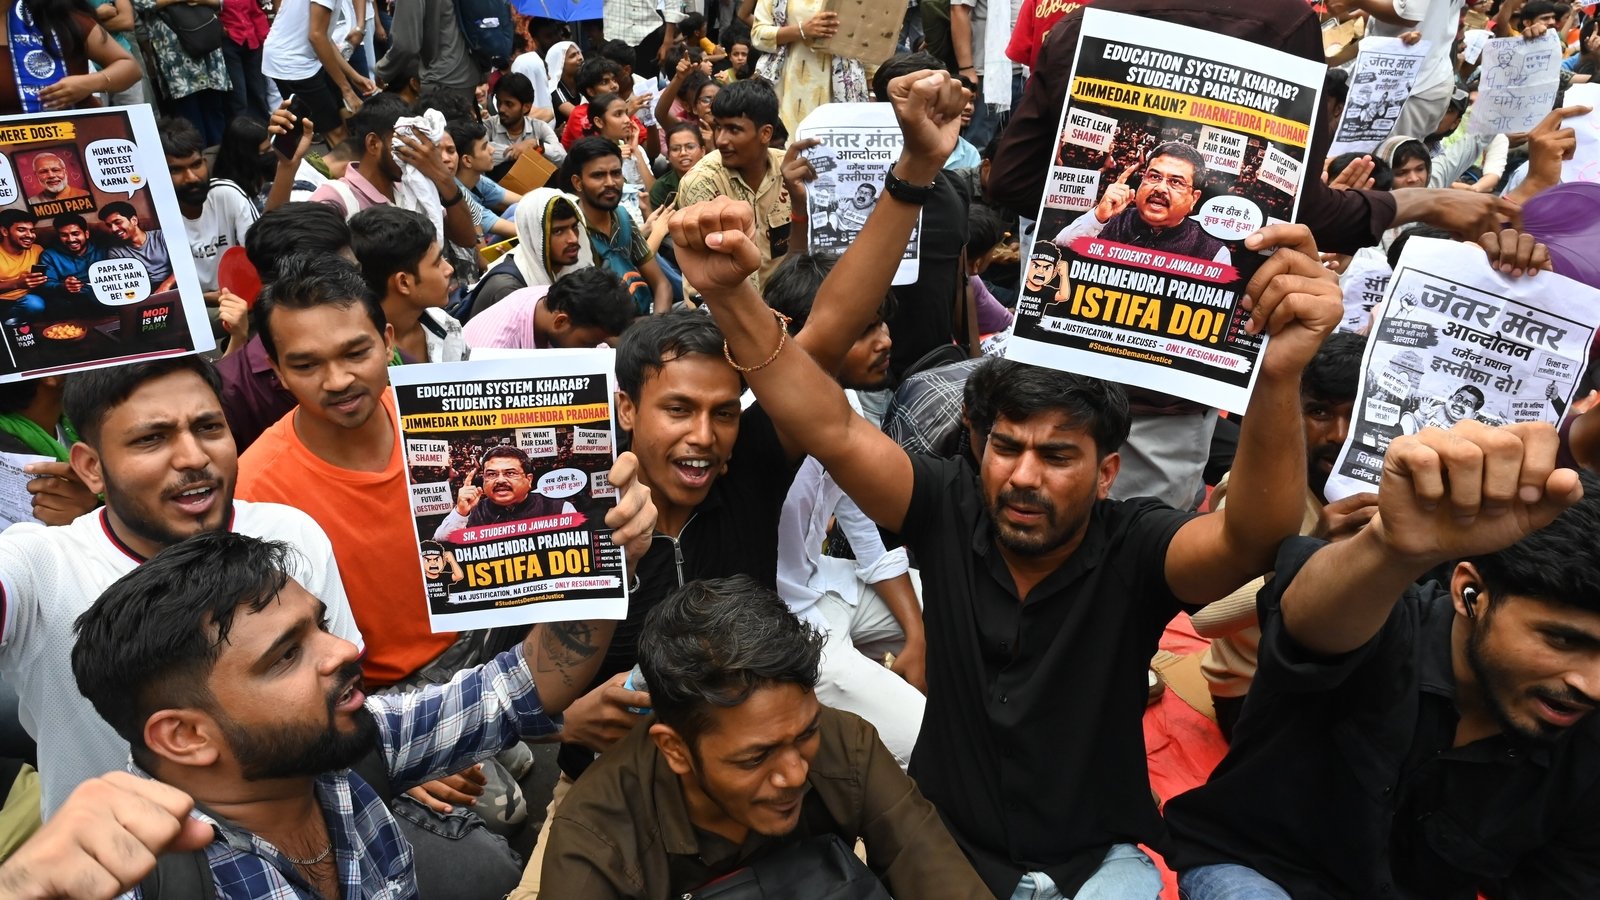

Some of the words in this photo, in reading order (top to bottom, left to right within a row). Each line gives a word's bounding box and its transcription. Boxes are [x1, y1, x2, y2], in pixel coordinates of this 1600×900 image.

[1370, 54, 1395, 68] जंतर
[1102, 43, 1183, 72] EDUCATION
[1184, 58, 1240, 84] SYSTEM
[1242, 72, 1299, 101] KHARAB?
[1126, 66, 1200, 94] STUDENTS
[1202, 81, 1279, 113] PARESHAN?
[1074, 81, 1140, 106] JIMMEDAR
[1143, 92, 1186, 114] KAUN?
[1190, 102, 1262, 131] DHARMENDRA
[1264, 118, 1308, 144] PRADHAN!
[1070, 114, 1092, 128] NEET
[1092, 120, 1112, 134] LEAK
[30, 126, 64, 140] DOST:
[1072, 128, 1104, 145] SHAME!
[1208, 132, 1220, 142] WE
[1222, 134, 1240, 147] WANT
[92, 146, 115, 156] HUME
[117, 145, 132, 154] KYA
[836, 147, 891, 160] आन्दोलन
[1203, 142, 1218, 152] FAIR
[1220, 146, 1240, 158] EXAMS
[98, 156, 132, 166] PROTEST
[1214, 156, 1238, 169] SCAMS!
[1270, 152, 1298, 172] EDUCATION
[100, 165, 134, 176] VROTEST
[838, 170, 874, 182] इस्तीफा
[1276, 166, 1287, 176] NOT
[100, 176, 128, 186] KARNA
[1053, 172, 1076, 180] PAPER
[1077, 174, 1094, 184] LEAK
[1262, 170, 1294, 191] CORRUPTION!
[1059, 184, 1085, 194] FUTURE
[33, 202, 63, 217] MODI
[65, 198, 93, 212] PAPA
[1050, 194, 1092, 207] DESTROYED!
[1212, 204, 1224, 214] सब
[1226, 206, 1242, 216] ठीक
[1204, 216, 1220, 226] कुछ
[1236, 221, 1254, 232] हुआ!
[98, 264, 118, 274] PAPA
[119, 262, 134, 270] SAB
[1088, 243, 1104, 257] SIR,
[1107, 246, 1152, 264] STUDENTS
[1152, 256, 1166, 267] KO
[1166, 258, 1204, 274] JAWAAB
[1204, 266, 1222, 279] DO!
[94, 274, 122, 284] JAANTE
[124, 271, 144, 280] HAIN,
[1070, 260, 1165, 295] DHARMENDRA
[1167, 279, 1234, 309] PRADHAN
[102, 282, 123, 292] CHILL
[124, 280, 140, 288] KAR
[143, 307, 168, 318] MODI
[1070, 284, 1161, 331] ISTIFA
[1167, 304, 1226, 344] DO!
[1421, 284, 1500, 328] जंतर
[1501, 310, 1567, 351] मंतर
[142, 322, 166, 332] PAPA
[16, 333, 34, 342] MODI
[1051, 320, 1061, 329] NA
[1062, 323, 1114, 340] JUSTIFICATION,
[1116, 334, 1126, 342] NA
[1126, 336, 1158, 348] EXCUSES
[1166, 344, 1186, 354] ONLY
[1186, 348, 1239, 368] RESIGNATION!
[1442, 322, 1534, 361] आन्दोलन
[1088, 342, 1172, 364] #StudentsDemandJustice
[1484, 358, 1512, 373] प्रधान
[1546, 358, 1561, 368] शिक्षा
[1430, 356, 1493, 386] इस्तीफा
[1494, 374, 1522, 395] दो!
[416, 383, 482, 398] EDUCATION
[486, 380, 532, 395] SYSTEM
[536, 378, 590, 392] KHARAB?
[442, 396, 502, 411] STUDENTS
[506, 392, 574, 408] PARESHAN?
[406, 416, 459, 430] JIMMEDAR
[462, 414, 497, 426] KAUN?
[500, 410, 564, 424] DHARMENDRA
[566, 406, 609, 420] PRADHAN!
[411, 444, 428, 452] NEET
[430, 444, 446, 452] LEAK
[416, 454, 442, 462] SHAME!
[1356, 452, 1383, 468] शिक्षा
[557, 475, 570, 483] ठीक
[413, 488, 432, 496] PAPER
[421, 495, 442, 503] FUTURE
[416, 503, 452, 512] DESTROYED!
[463, 532, 478, 541] SIR,
[480, 524, 516, 538] STUDENTS
[518, 523, 527, 532] KO
[529, 518, 558, 530] JAWAAB
[560, 516, 572, 526] DO!
[455, 537, 536, 562] DHARMENDRA
[538, 531, 589, 550] PRADHAN
[466, 554, 544, 588] ISTIFA
[548, 548, 590, 576] DO!
[468, 590, 512, 600] JUSTIFICATION,
[523, 583, 548, 594] EXCUSES
[572, 579, 611, 588] RESIGNATION!
[495, 593, 564, 606] #StudentsDemandJustice
